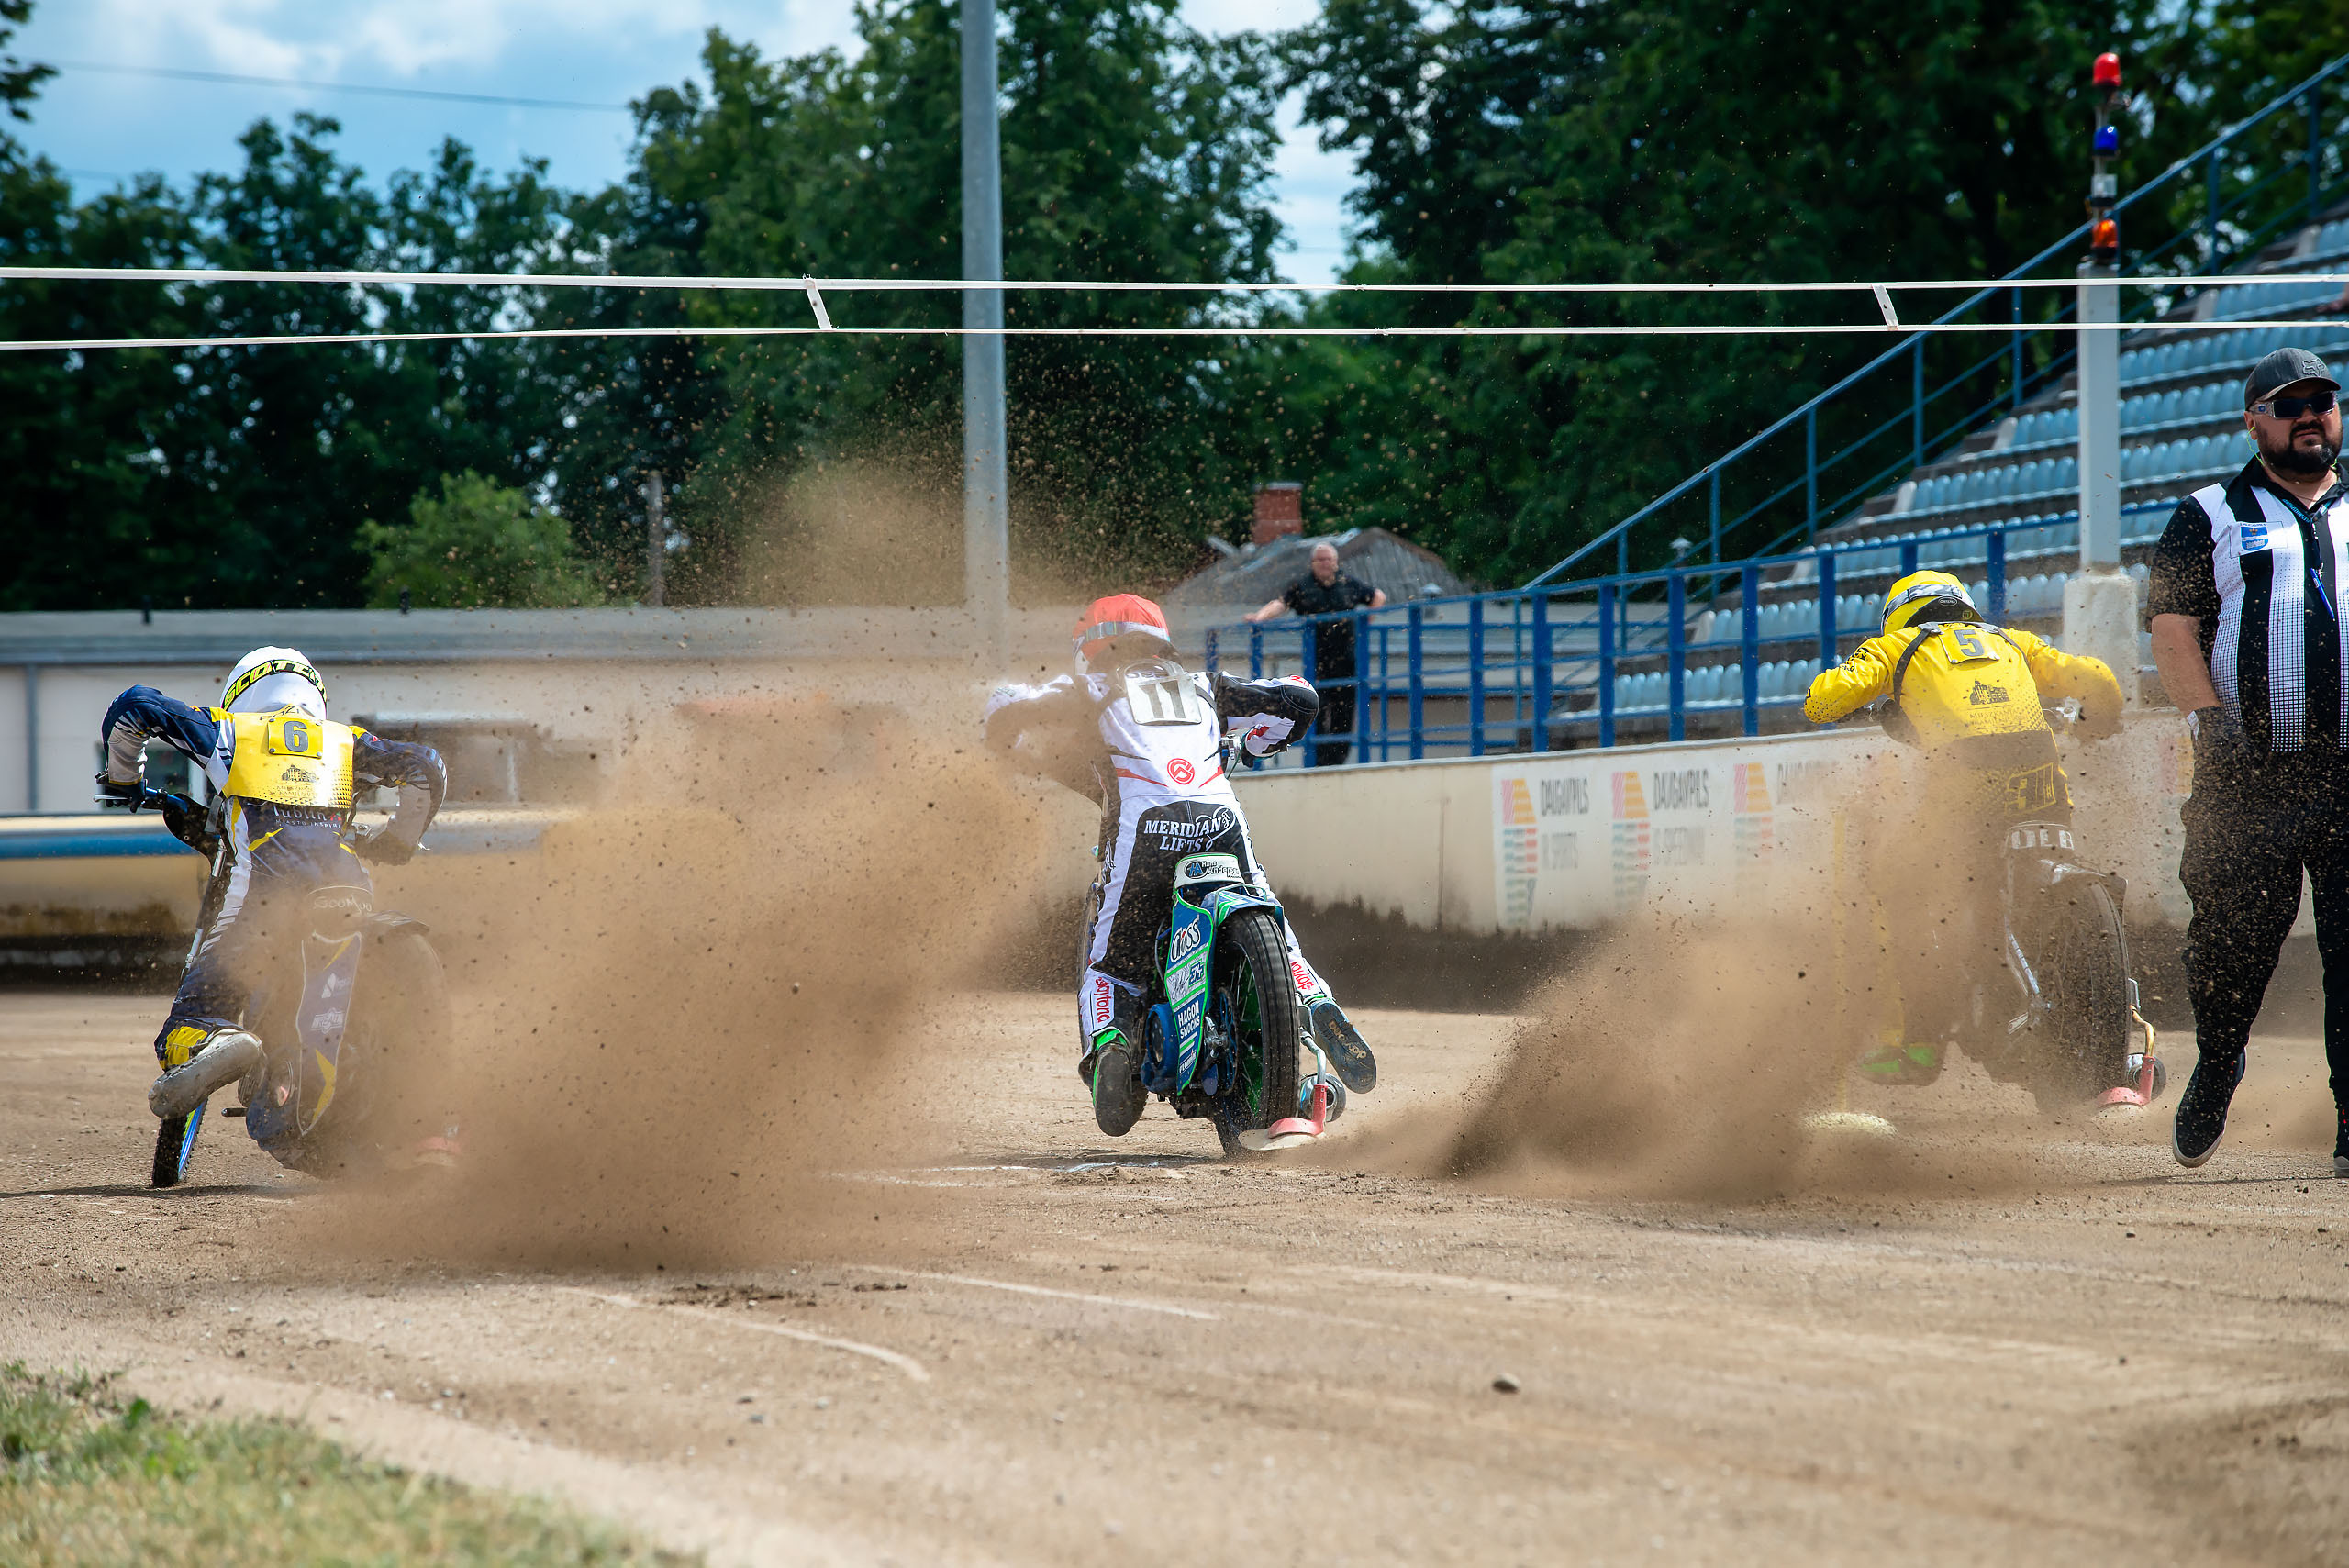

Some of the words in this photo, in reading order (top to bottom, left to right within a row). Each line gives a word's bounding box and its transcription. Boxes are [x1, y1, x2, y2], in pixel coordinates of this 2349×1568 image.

[1954, 629, 1985, 657] 5
[1138, 679, 1186, 719] 11
[284, 720, 309, 752] 6
[1541, 777, 1589, 817] DAUGAVPILS
[1654, 768, 1710, 811] DAUGAVPILS
[1143, 817, 1222, 838] MERIDIAN
[1159, 835, 1204, 853] LIFTS
[1178, 999, 1200, 1028] HAGON
[1180, 1015, 1200, 1040] SHOCKS
